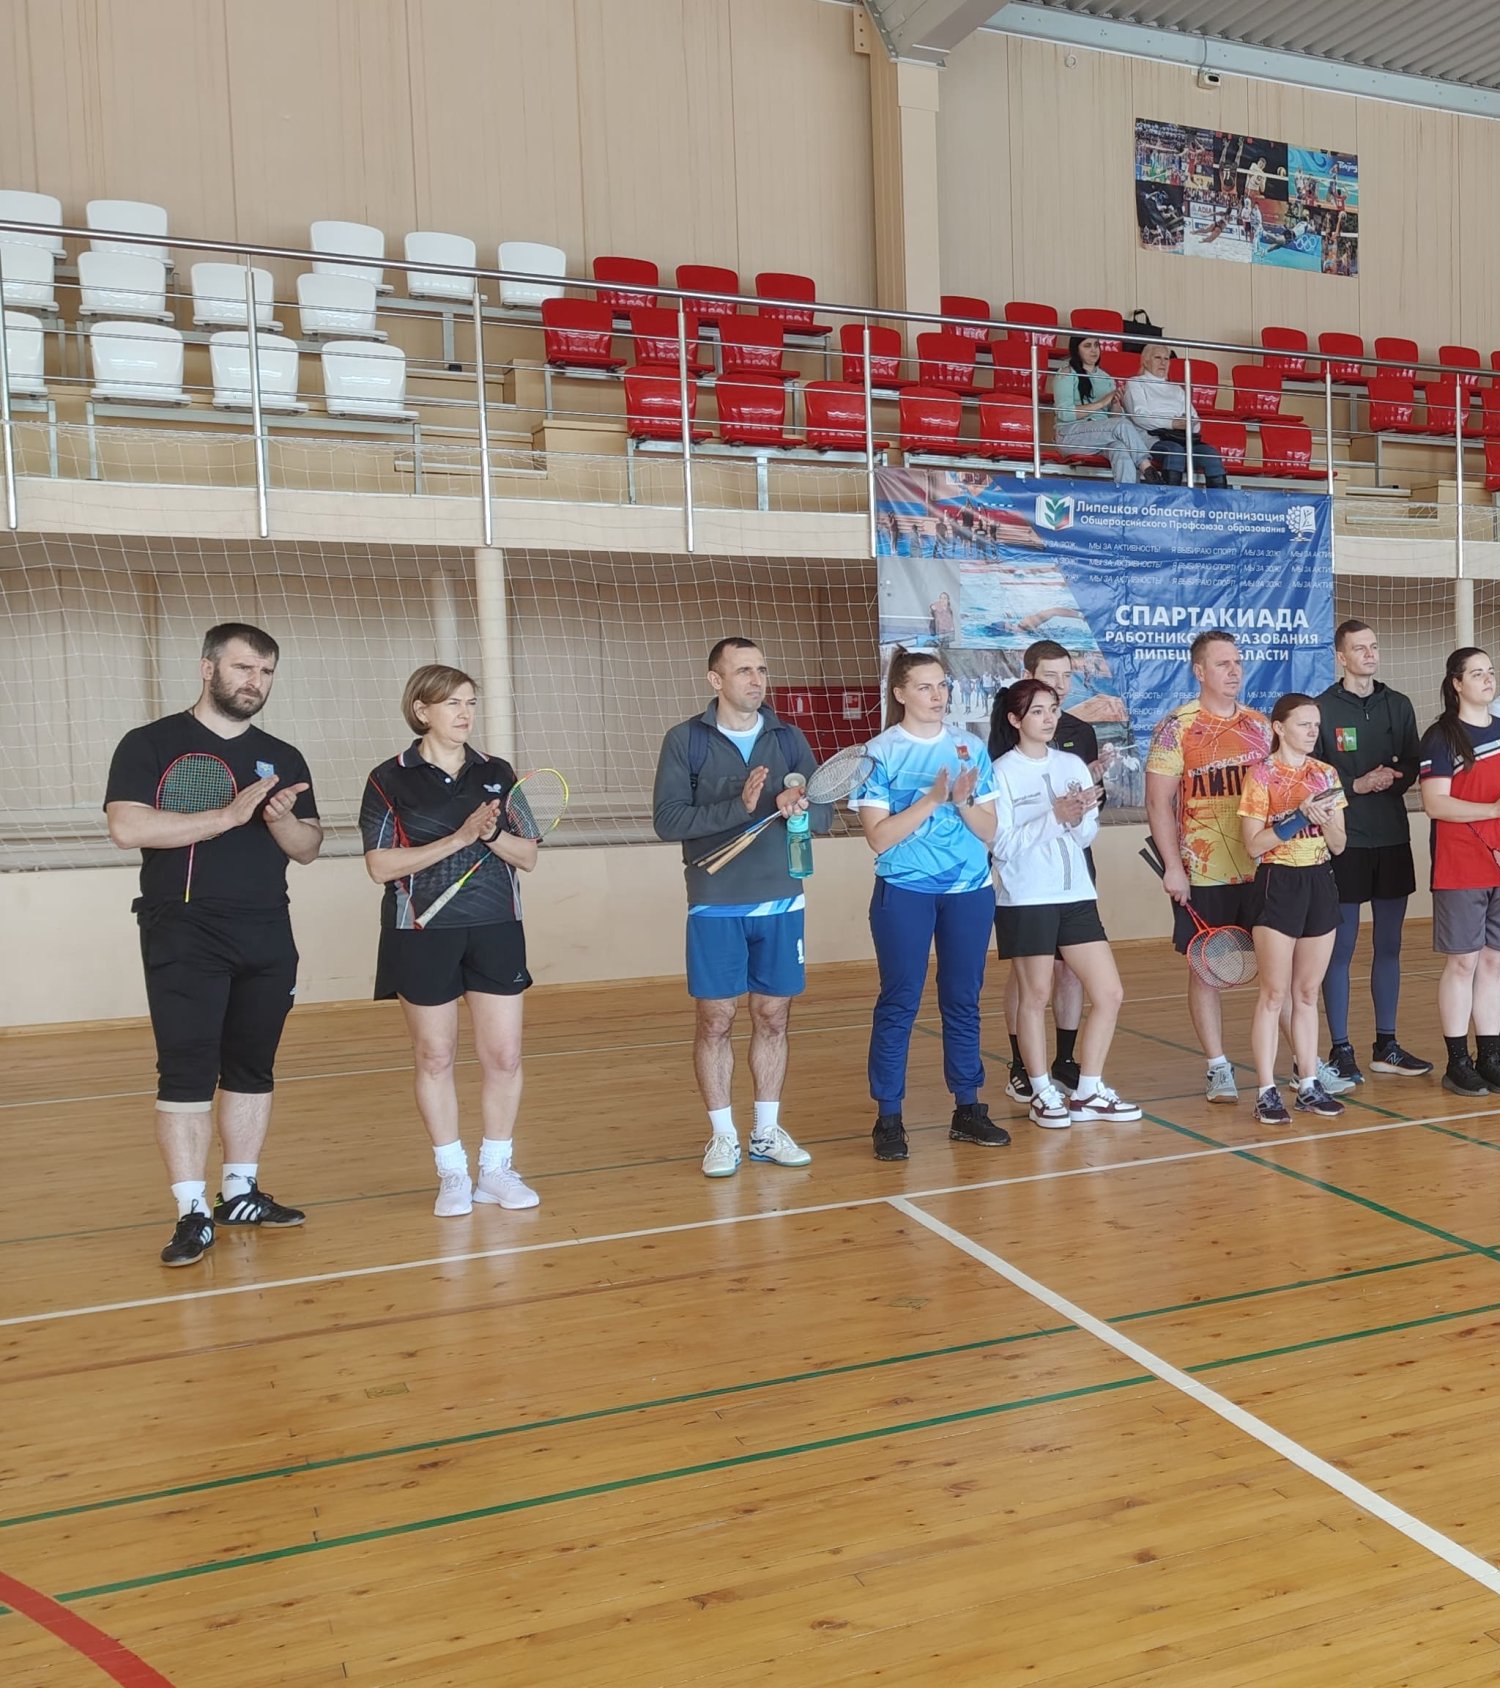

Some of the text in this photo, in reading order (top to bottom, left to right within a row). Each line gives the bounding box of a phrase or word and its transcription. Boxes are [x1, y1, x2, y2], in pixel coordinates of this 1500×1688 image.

[1076, 501, 1285, 523] Липецкая областная организация
[1080, 515, 1286, 534] Общероссийского Профсоюза образования
[1088, 542, 1161, 553] МЫ ЗА АКТИВНОСТЬ!
[1115, 605, 1309, 631] СПАРТАКИАДА
[1105, 631, 1319, 645] РАБОТНИКО РАЗОВАНИЯ
[1134, 648, 1289, 661] ЛИПЕЦ БЛАСТИ
